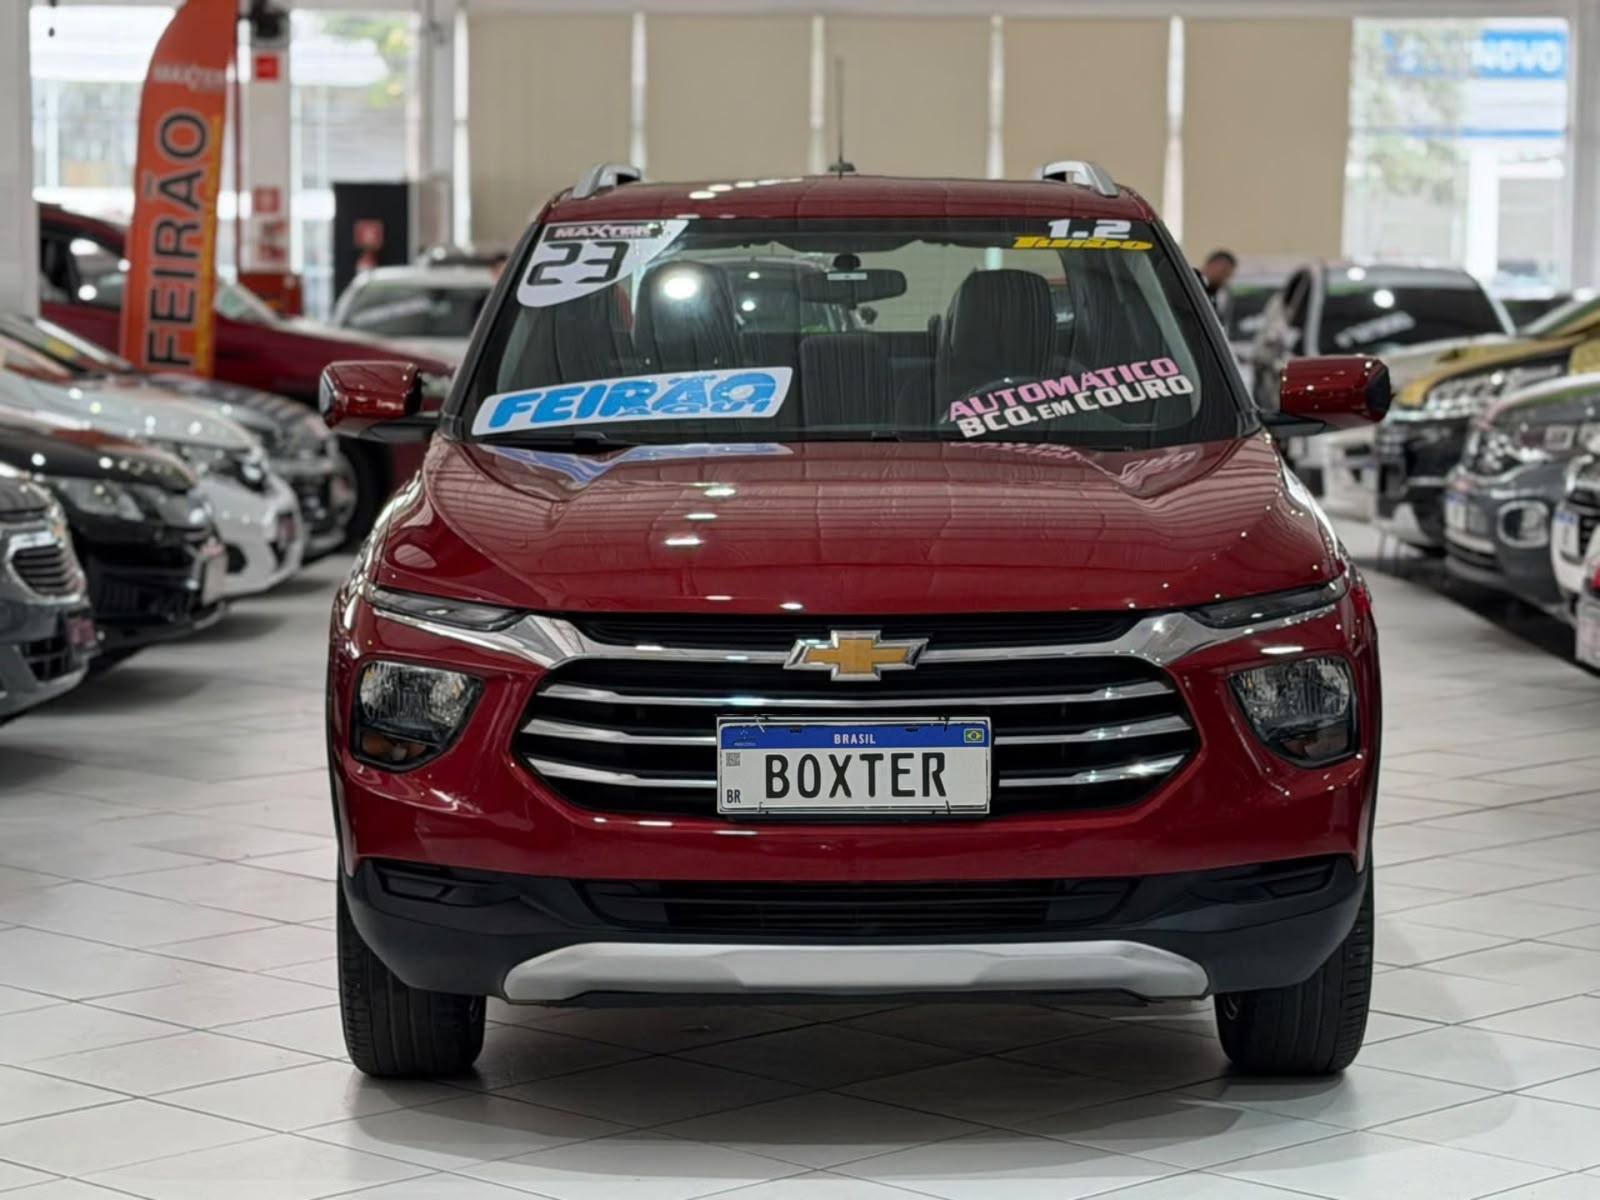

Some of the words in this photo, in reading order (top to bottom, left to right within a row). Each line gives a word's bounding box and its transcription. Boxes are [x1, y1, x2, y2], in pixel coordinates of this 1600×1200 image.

[146, 112, 208, 367] FEIRÃO
[1047, 219, 1131, 239] 1.2
[526, 241, 630, 286] 23
[488, 372, 776, 428] FEIRÃO
[1037, 400, 1077, 420] EM
[1074, 375, 1194, 411] COURO
[833, 733, 876, 745] BRASIL
[726, 788, 742, 804] BR
[765, 752, 946, 799] BOXTER
